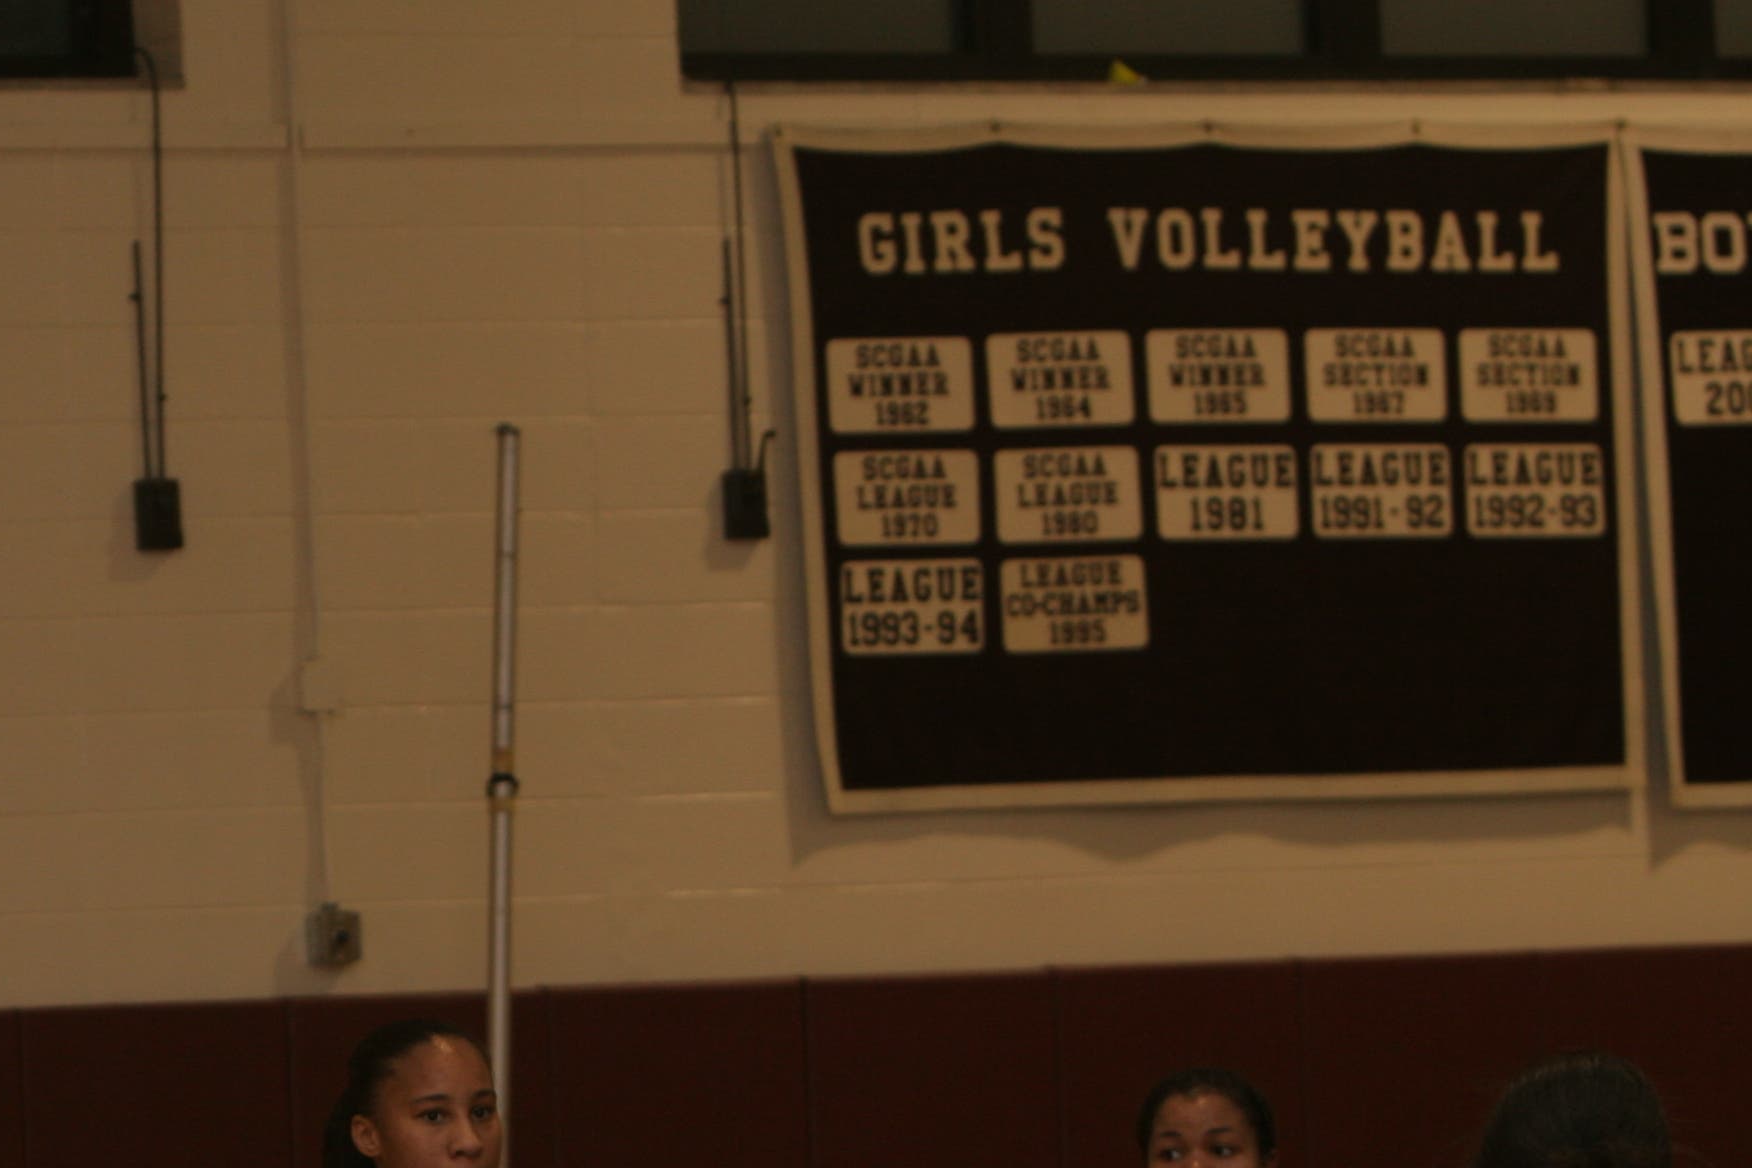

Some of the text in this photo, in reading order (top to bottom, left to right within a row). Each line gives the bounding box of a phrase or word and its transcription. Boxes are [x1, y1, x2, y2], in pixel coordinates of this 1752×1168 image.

[857, 206, 1560, 275] GIRLS VOLLEYBALL
[1653, 210, 1752, 275] BO
[848, 371, 949, 398] WINNER
[1011, 365, 1110, 391] WINNER
[1170, 363, 1265, 387] WINNER
[1324, 363, 1428, 387] SECTION
[1477, 363, 1580, 387] SECTION
[1706, 380, 1752, 416] 20
[1159, 453, 1293, 488] LEAGUE
[1314, 453, 1445, 486] LEAGUE
[1468, 453, 1598, 486] LEAGUE
[857, 484, 957, 510] LEAGUE
[1017, 482, 1117, 507] LEAGUE
[1191, 498, 1263, 531] 1981
[846, 565, 981, 604] LEAGUE
[1019, 561, 1122, 588] LEAGUE
